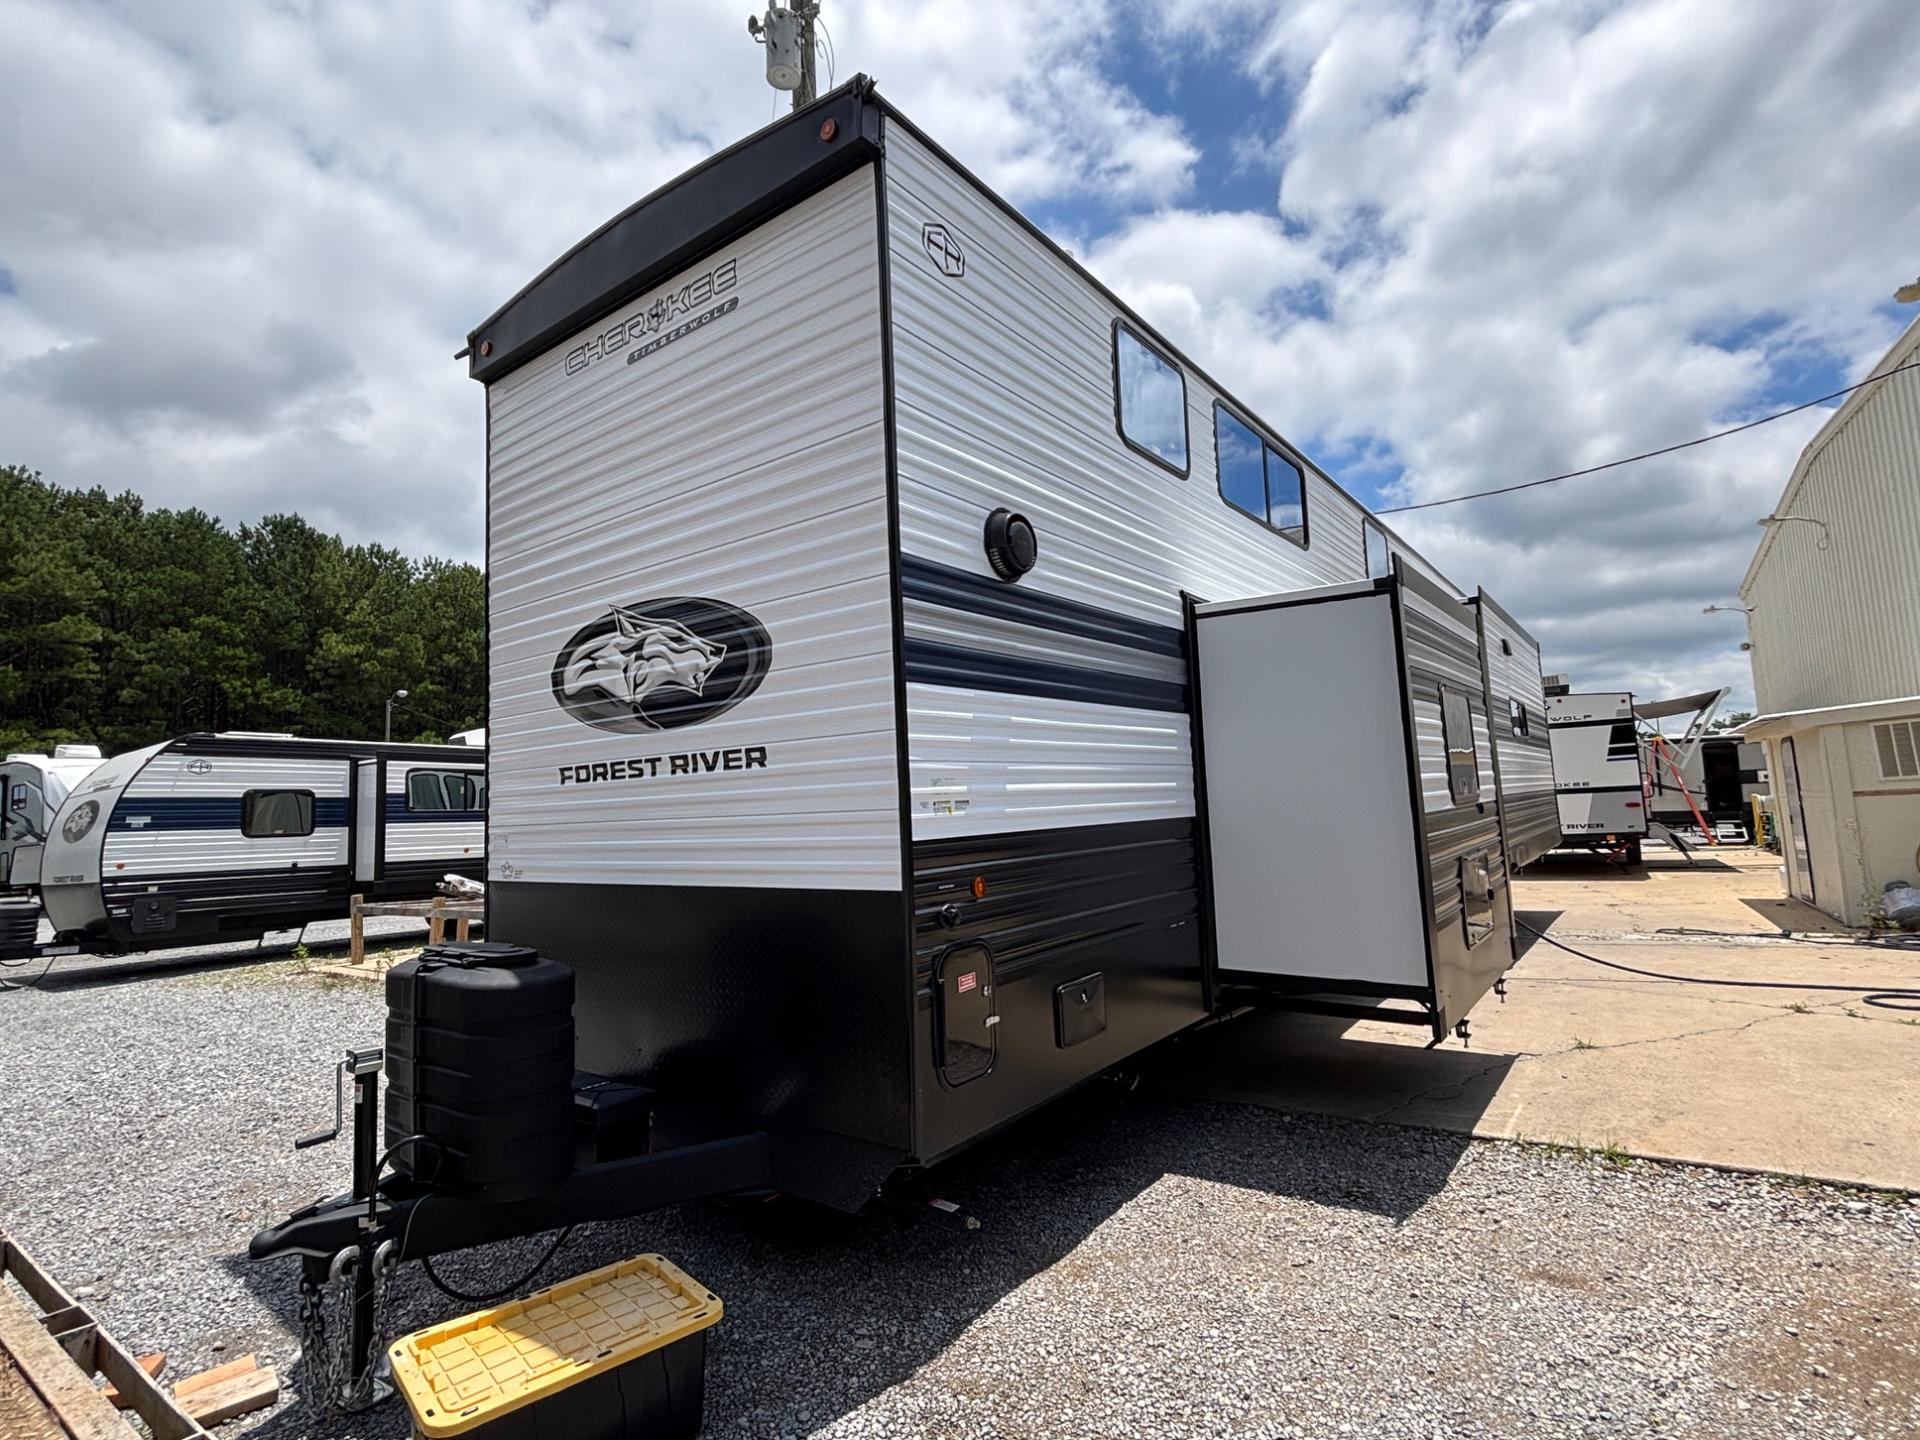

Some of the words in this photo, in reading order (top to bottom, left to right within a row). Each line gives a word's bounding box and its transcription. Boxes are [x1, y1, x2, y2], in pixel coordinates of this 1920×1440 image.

[632, 301, 733, 361] TIMBERWOLF
[1550, 714, 1592, 722] WOLF
[558, 757, 663, 785] FOREST
[669, 746, 768, 775] RIVER
